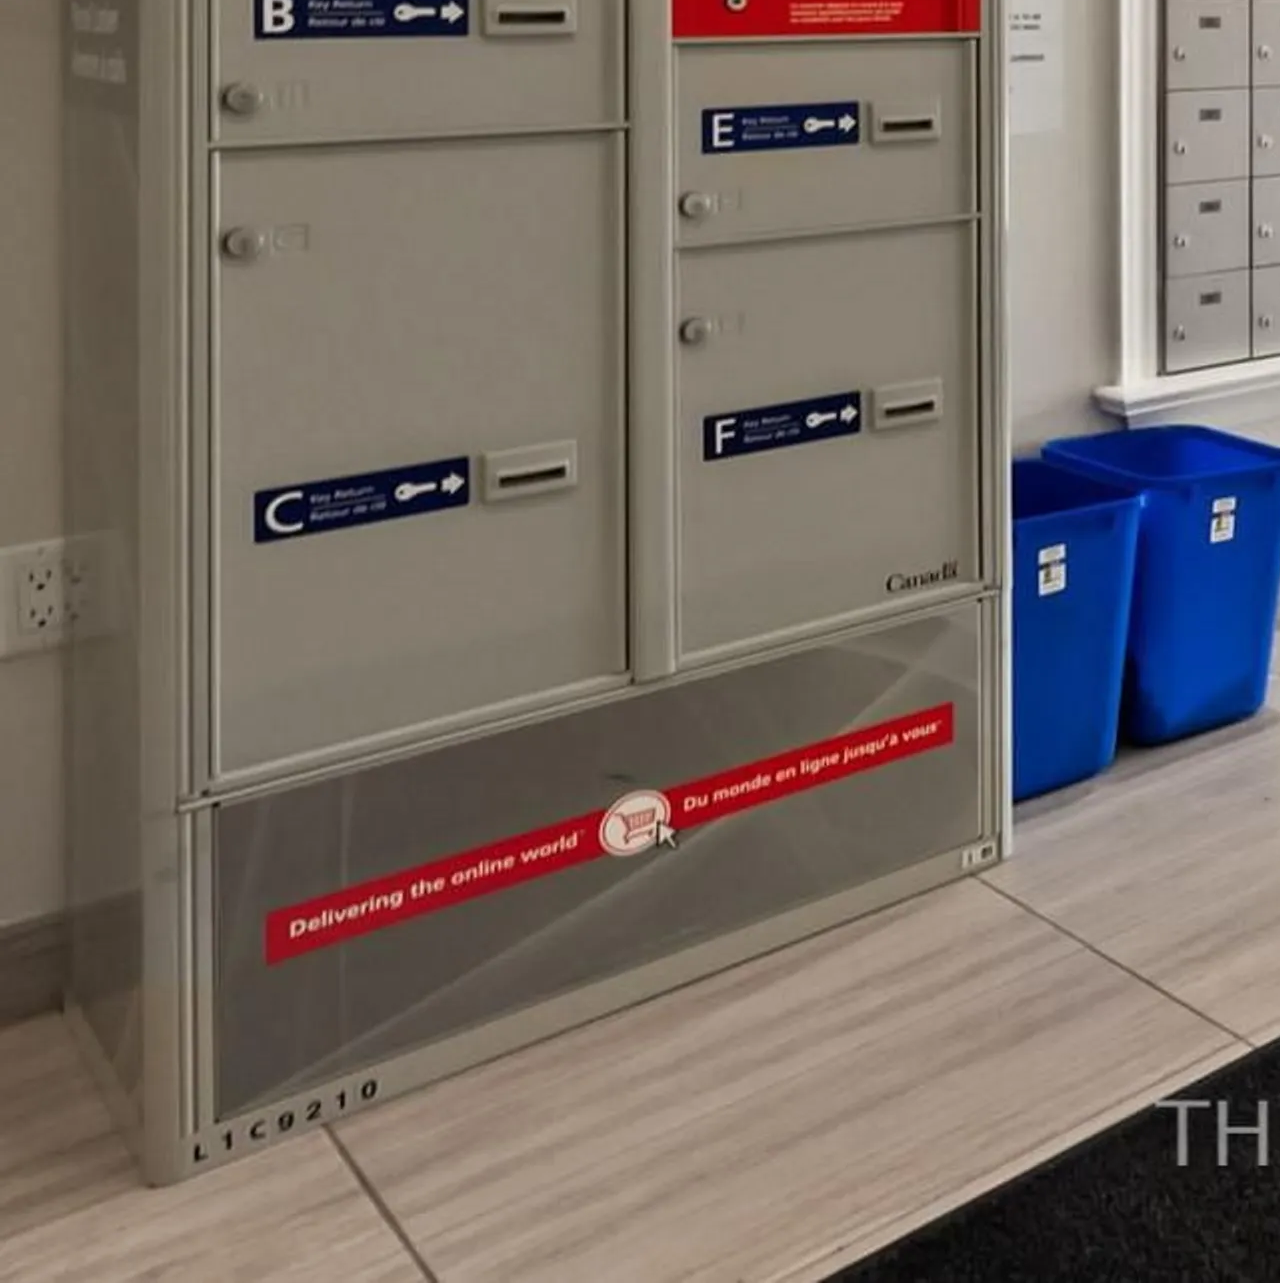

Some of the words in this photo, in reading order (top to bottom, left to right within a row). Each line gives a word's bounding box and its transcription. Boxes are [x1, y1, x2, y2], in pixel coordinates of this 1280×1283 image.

[712, 113, 735, 147] E
[715, 419, 737, 454] F
[265, 491, 304, 533] C
[684, 794, 708, 812] Du
[713, 774, 771, 802] monde
[775, 766, 796, 783] en
[800, 751, 840, 776] ligne
[844, 732, 899, 765] jusqu'à
[903, 721, 938, 742] vous
[289, 890, 404, 939] Delivering
[411, 876, 445, 899] the
[451, 854, 514, 886] online
[520, 831, 579, 863] world
